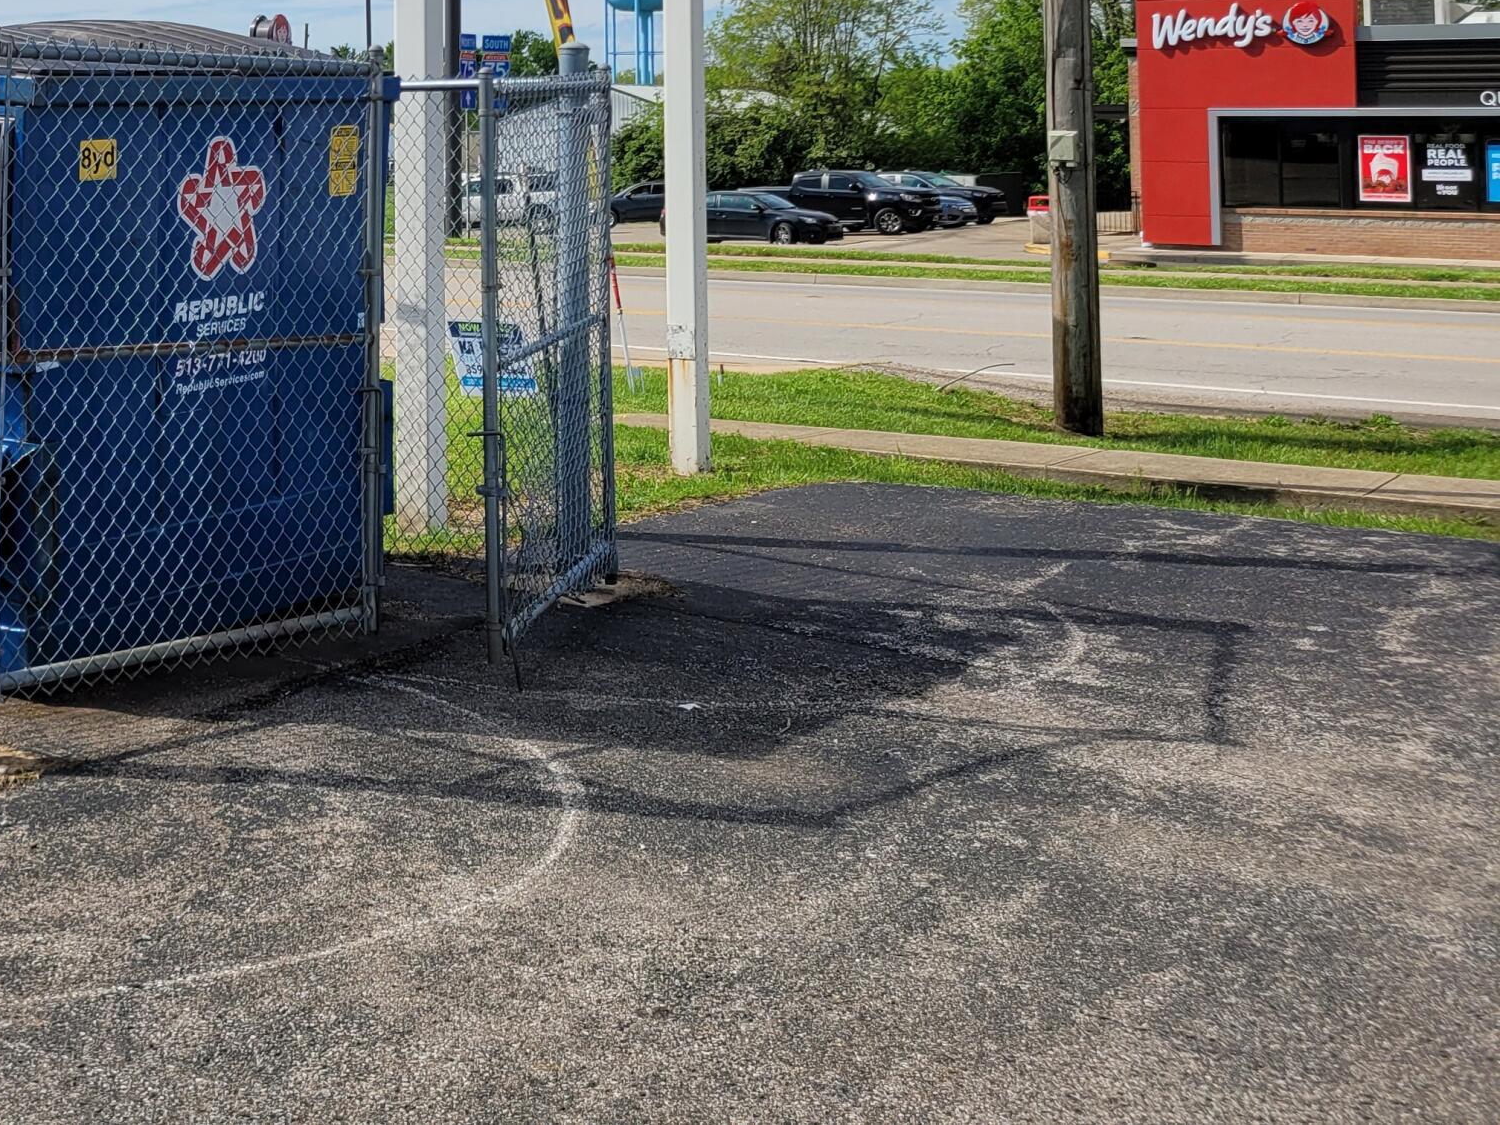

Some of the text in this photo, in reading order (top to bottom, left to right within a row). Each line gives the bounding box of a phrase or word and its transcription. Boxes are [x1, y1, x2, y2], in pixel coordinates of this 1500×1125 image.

[1152, 2, 1273, 49] Wendy's
[484, 39, 508, 49] SOUTH
[461, 61, 475, 78] 75
[1363, 144, 1405, 154] BACK
[1426, 149, 1466, 159] REAL
[81, 146, 115, 174] 8yd
[174, 291, 265, 323] REPUBLIC
[196, 318, 247, 337] SERVICES
